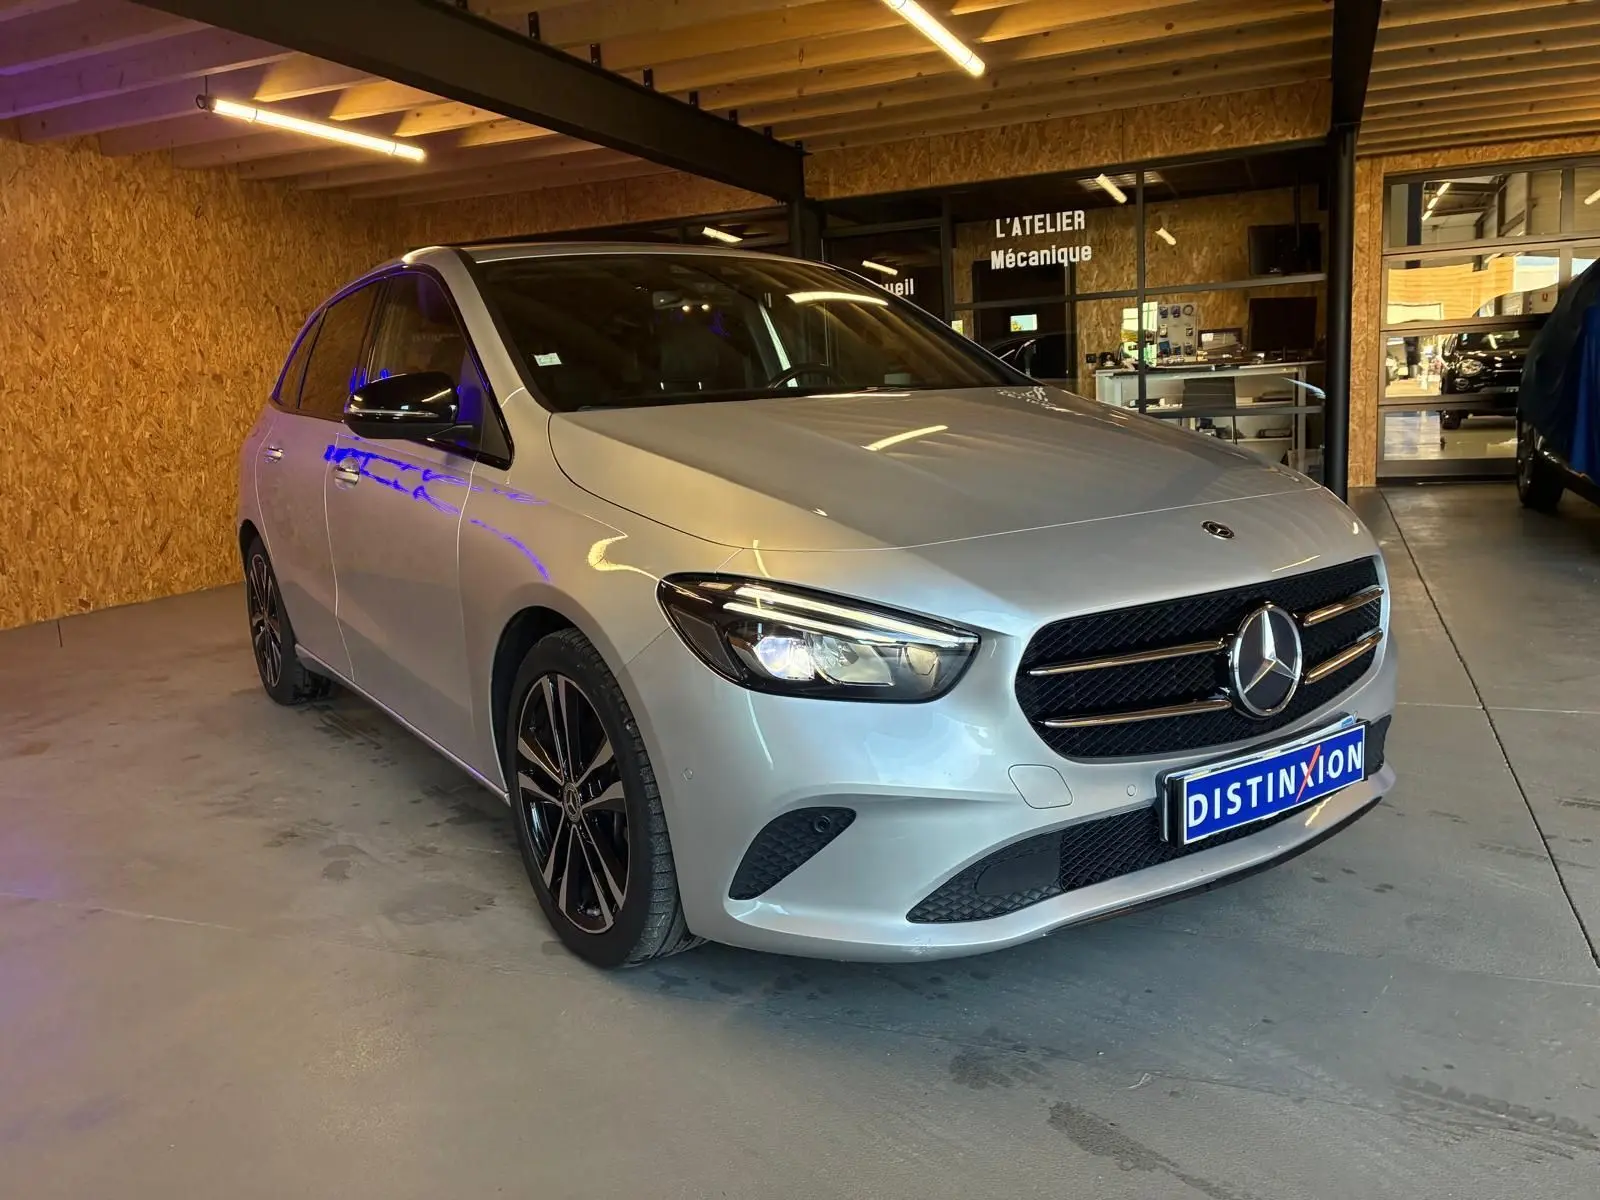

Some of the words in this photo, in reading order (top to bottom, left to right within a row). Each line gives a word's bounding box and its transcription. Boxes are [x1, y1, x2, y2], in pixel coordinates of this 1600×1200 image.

[995, 210, 1086, 238] L'ATELIER
[990, 244, 1092, 270] Mécanique
[880, 278, 914, 296] ueil
[1187, 741, 1363, 828] DISTINXION
